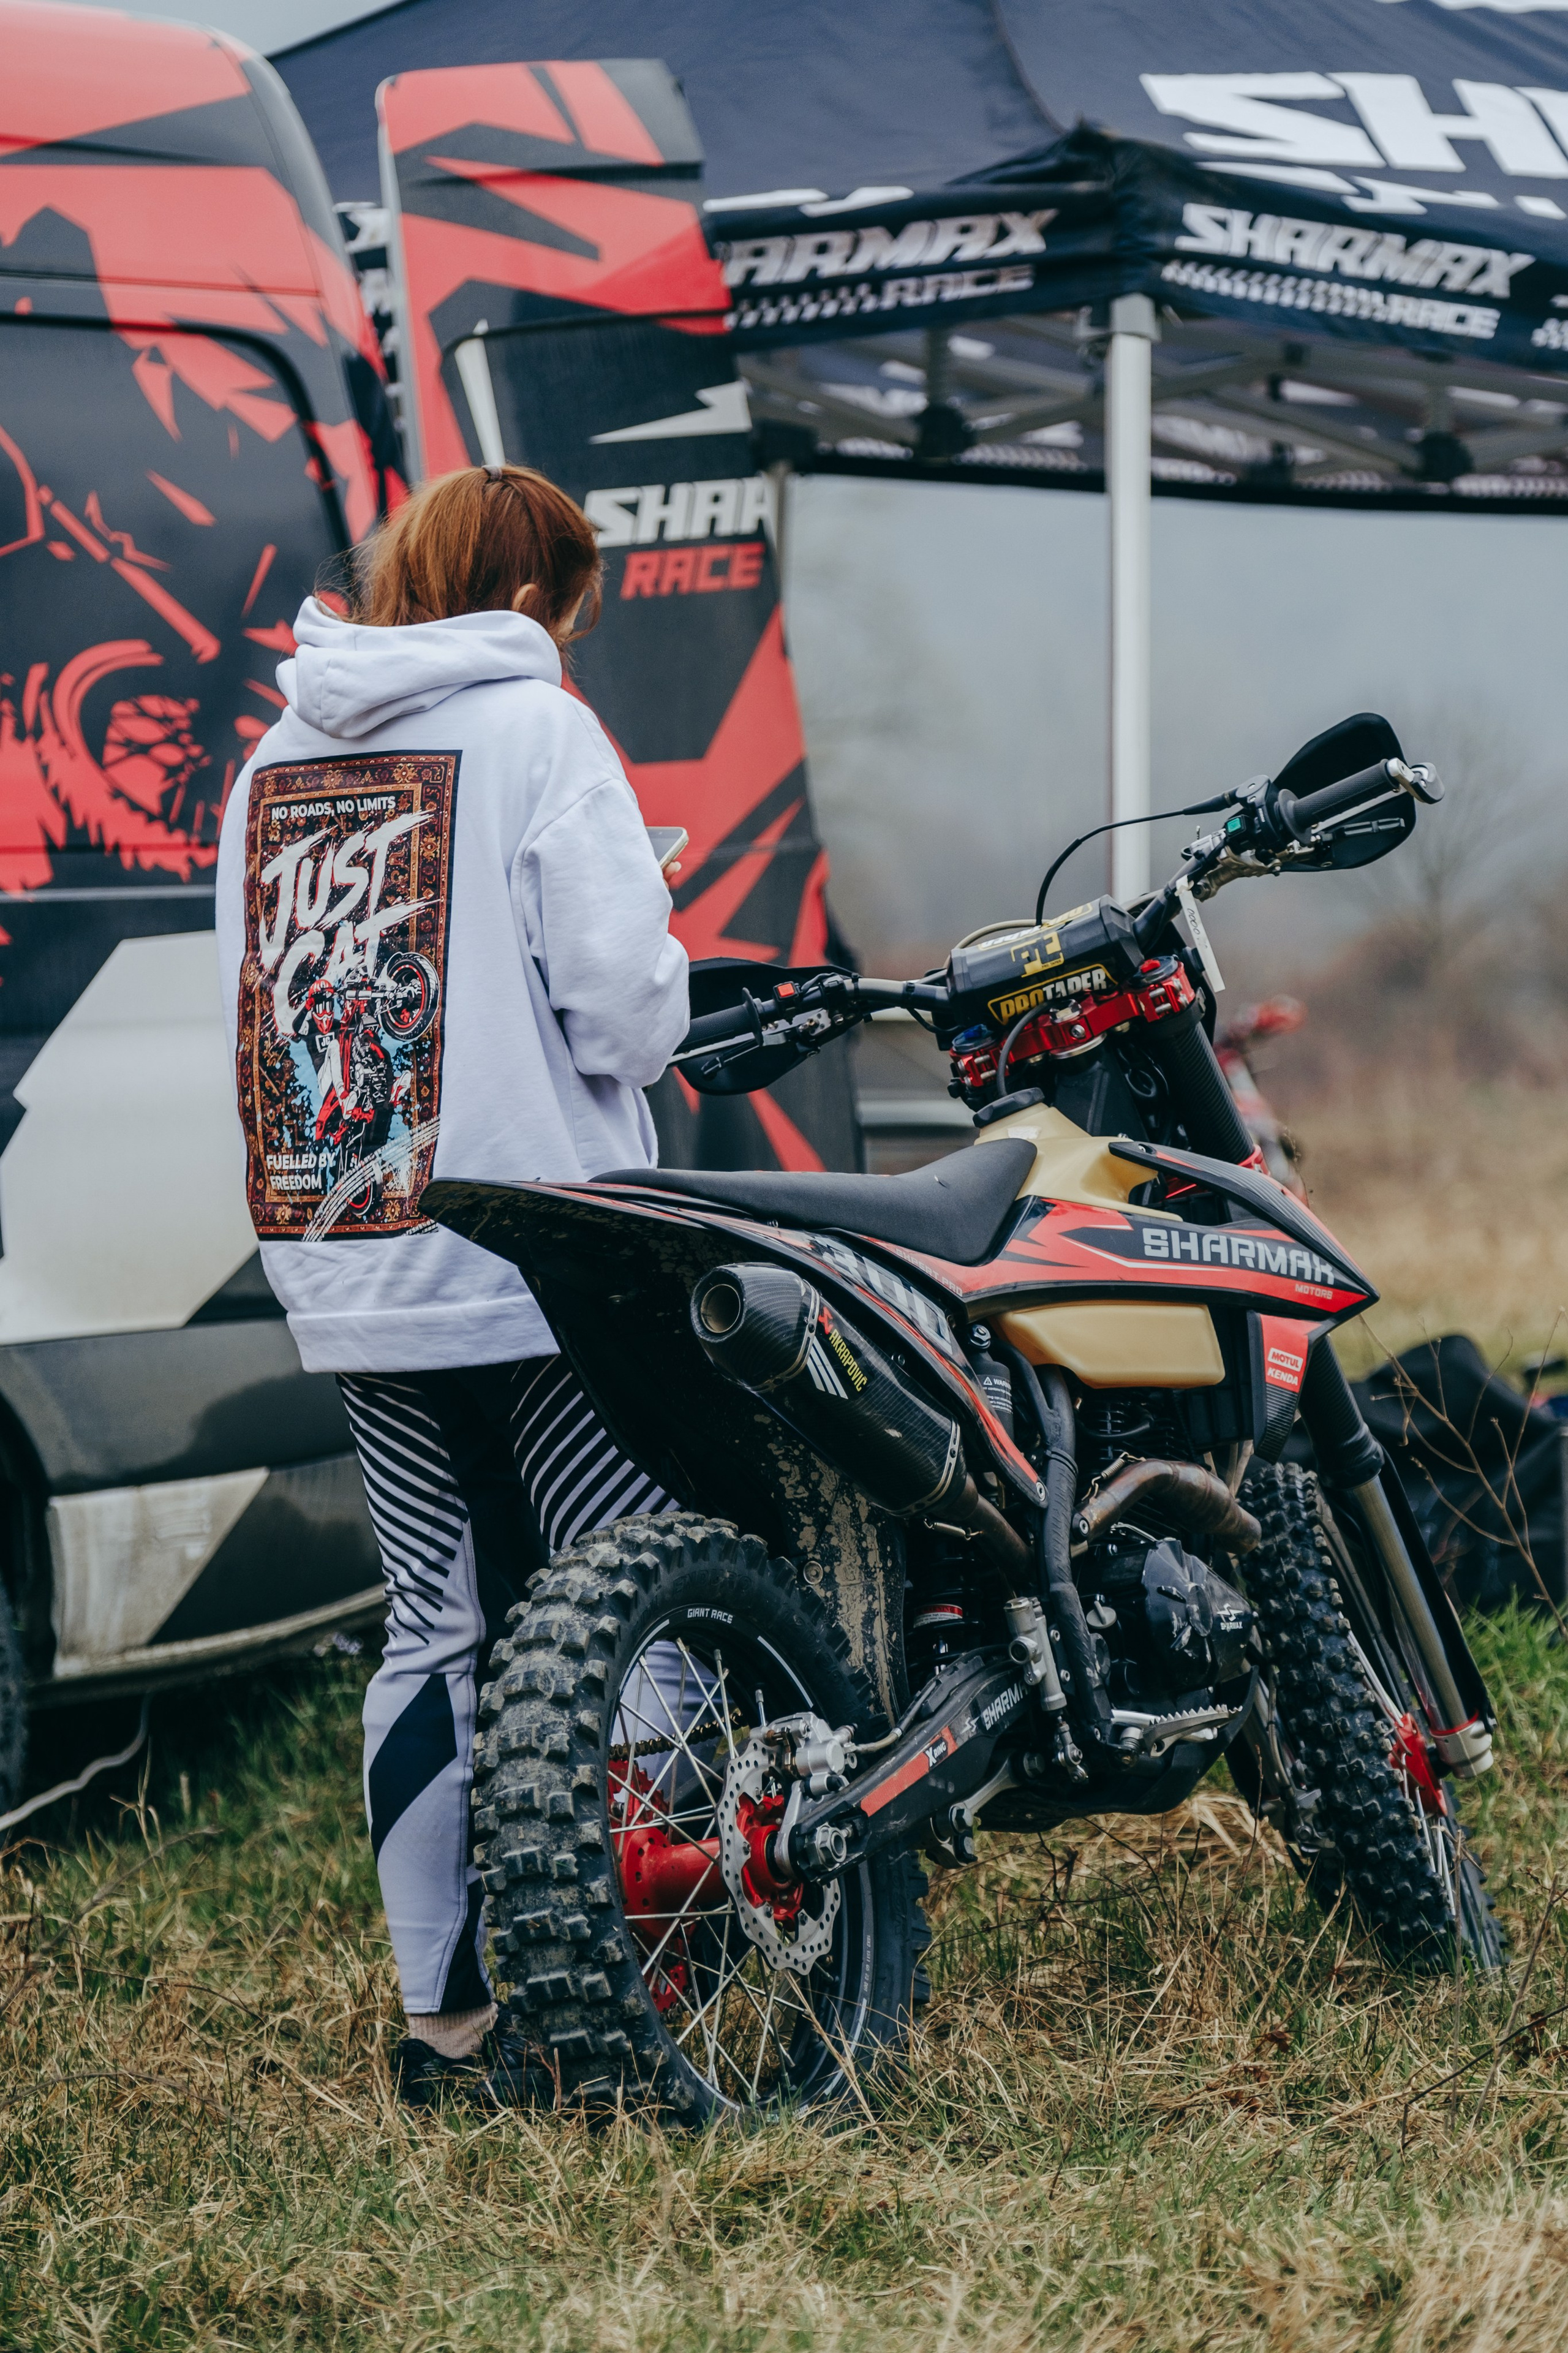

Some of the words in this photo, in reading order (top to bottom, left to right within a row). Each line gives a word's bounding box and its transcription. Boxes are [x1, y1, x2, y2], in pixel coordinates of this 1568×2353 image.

[1138, 71, 1568, 180] SH
[1174, 202, 1536, 299] SHARMAX
[878, 263, 1035, 309] RACE
[1383, 293, 1501, 339] RACE
[620, 542, 765, 600] RACE
[271, 806, 288, 821] NO
[290, 801, 334, 818] ROADS,
[336, 799, 355, 814] NO
[356, 796, 396, 812] LIMITS
[258, 810, 437, 971] JUST
[273, 899, 442, 1035] CAT
[321, 1036, 331, 1047] JC
[266, 1152, 317, 1170] FUELLED
[318, 1151, 336, 1168] BY
[270, 1174, 322, 1191] FREEDOM
[895, 1247, 940, 1281] EXPERT
[941, 1276, 963, 1297] PRO
[1142, 1227, 1335, 1285] SHARMAX
[1295, 1283, 1333, 1301] MOTORS
[1267, 1367, 1298, 1386] KENDA
[1271, 1351, 1300, 1369] MOTUL
[687, 1607, 710, 1618] GIANT
[710, 1609, 734, 1625] RACE
[933, 1741, 947, 1759] RING
